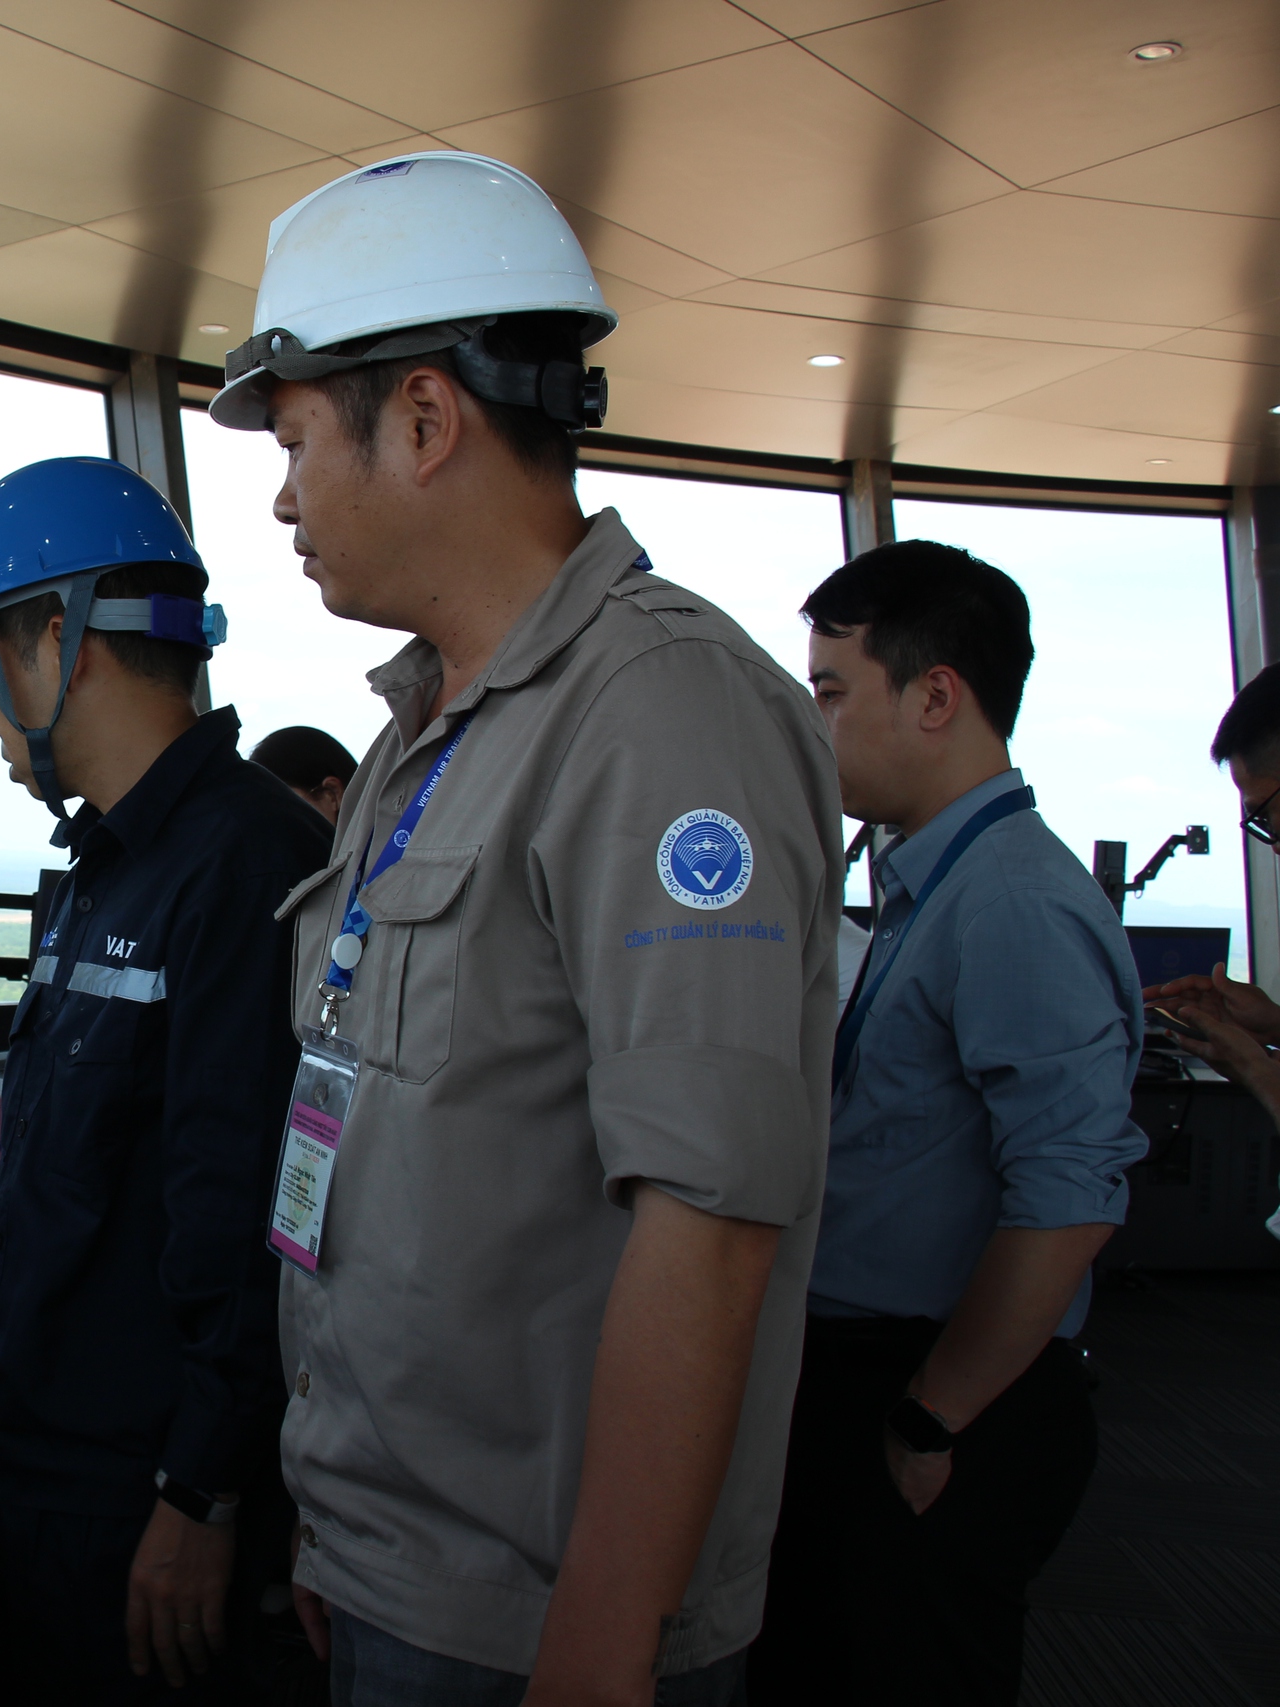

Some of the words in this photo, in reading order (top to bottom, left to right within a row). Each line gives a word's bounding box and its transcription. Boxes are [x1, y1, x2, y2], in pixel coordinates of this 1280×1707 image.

[417, 775, 440, 808] VIETNAM
[437, 760, 448, 774] AIR
[444, 730, 465, 759] TRAFFIC
[674, 821, 686, 833] TY
[686, 809, 718, 824] QUẢN
[720, 815, 732, 828] LÝ
[731, 825, 747, 845] BAY
[659, 833, 676, 867] CÔNG
[742, 848, 752, 869] VIỆT
[663, 869, 682, 897] TỔNG
[732, 871, 749, 895] NAM
[692, 894, 725, 905] VATM
[624, 929, 653, 948] CÔNG
[656, 927, 668, 942] TY
[670, 920, 703, 940] QUẢN
[707, 920, 719, 938] LÝ
[722, 923, 742, 938] BAY
[744, 919, 768, 939] MIỀN
[769, 921, 786, 942] BẮC
[105, 934, 140, 959] VAT
